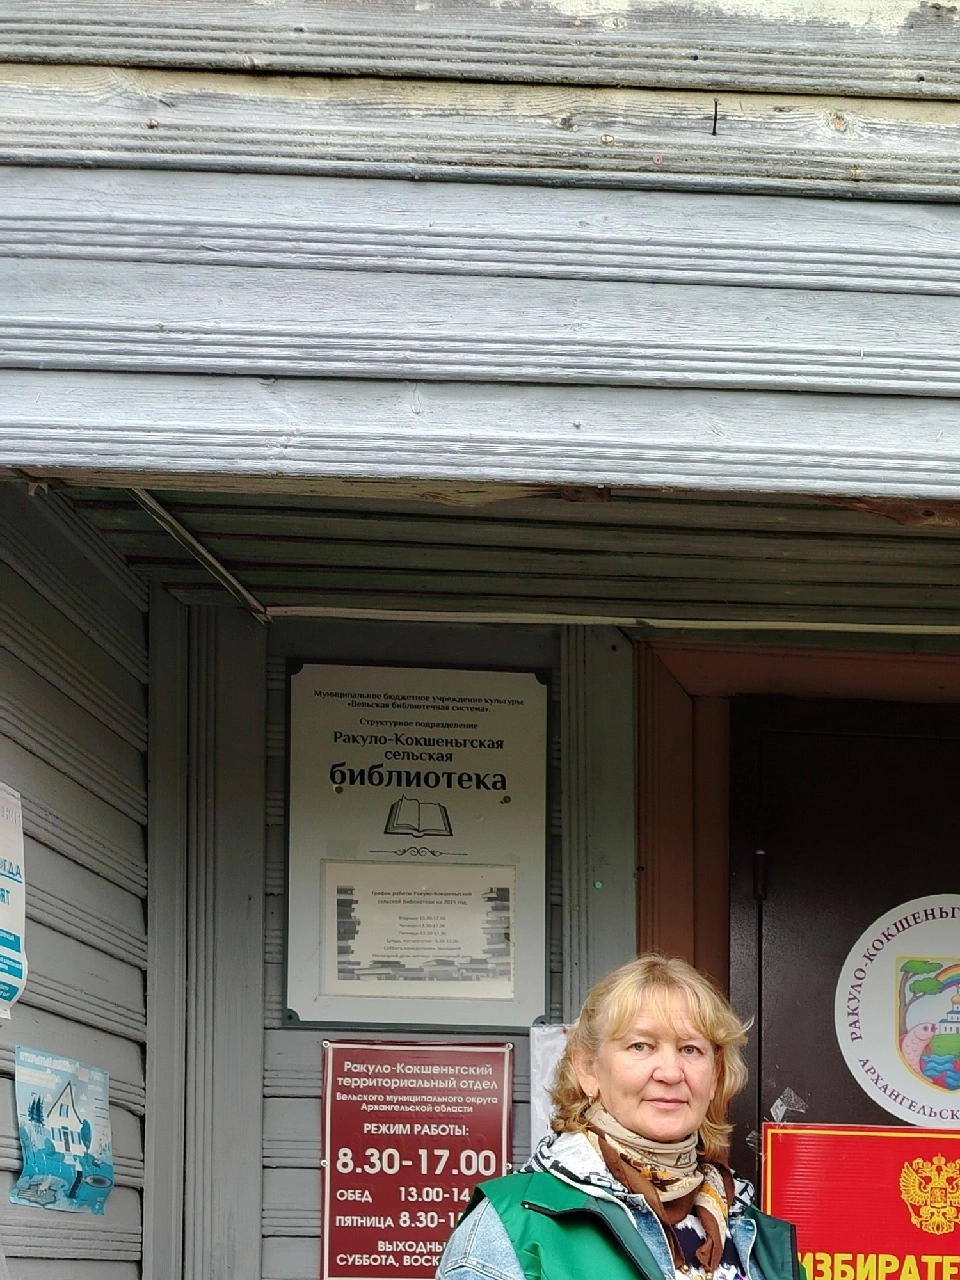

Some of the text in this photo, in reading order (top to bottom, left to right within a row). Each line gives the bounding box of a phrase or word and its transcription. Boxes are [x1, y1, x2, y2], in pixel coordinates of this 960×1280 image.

[383, 692, 430, 703] бюджетное
[432, 695, 482, 705] учреждение
[391, 702, 450, 711] библиотечная
[359, 717, 478, 730] Структурное подразделение
[333, 731, 504, 749] Ракуло-Кокшеньгская
[384, 750, 453, 762] сельская
[330, 761, 507, 791] библиотека
[343, 1060, 493, 1077] Ракуло-Кокшеньгский
[337, 1077, 499, 1091] территориальный отдел
[336, 1092, 498, 1106] Вельского муниципального округа
[360, 1102, 473, 1114] Архангельской области
[363, 1123, 470, 1137] РЕЖИМ РАБОТЫ:
[336, 1147, 497, 1177] 8.30-17.00
[336, 1189, 373, 1203] ОБЕД
[335, 1215, 395, 1229] ПЯТНИЦА
[336, 1254, 400, 1268] СУББОТА,
